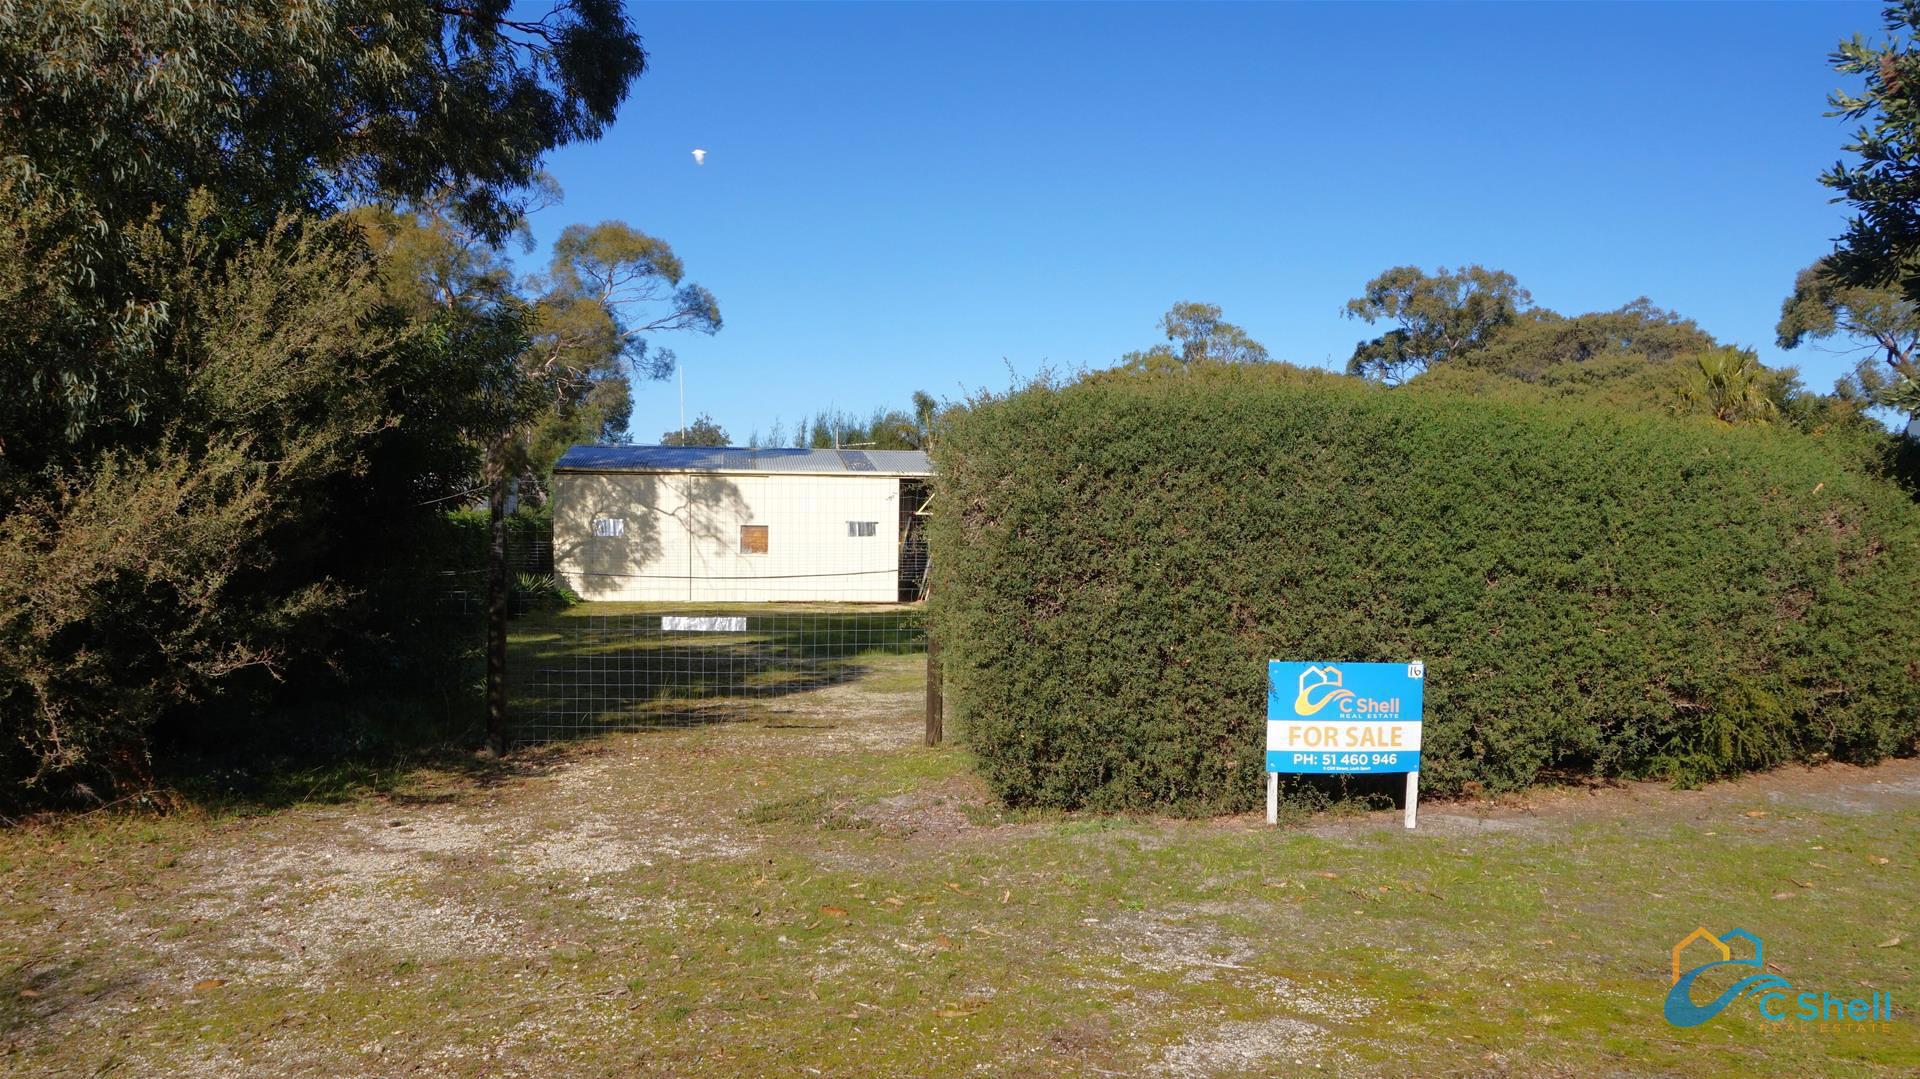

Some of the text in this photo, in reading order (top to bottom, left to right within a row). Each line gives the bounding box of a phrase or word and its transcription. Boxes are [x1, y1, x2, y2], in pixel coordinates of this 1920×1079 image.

[1410, 666, 1422, 676] 16
[1340, 698, 1400, 713] C Shell
[1288, 726, 1402, 747] FOR SALE
[1293, 753, 1397, 765] PH: 51 460 946
